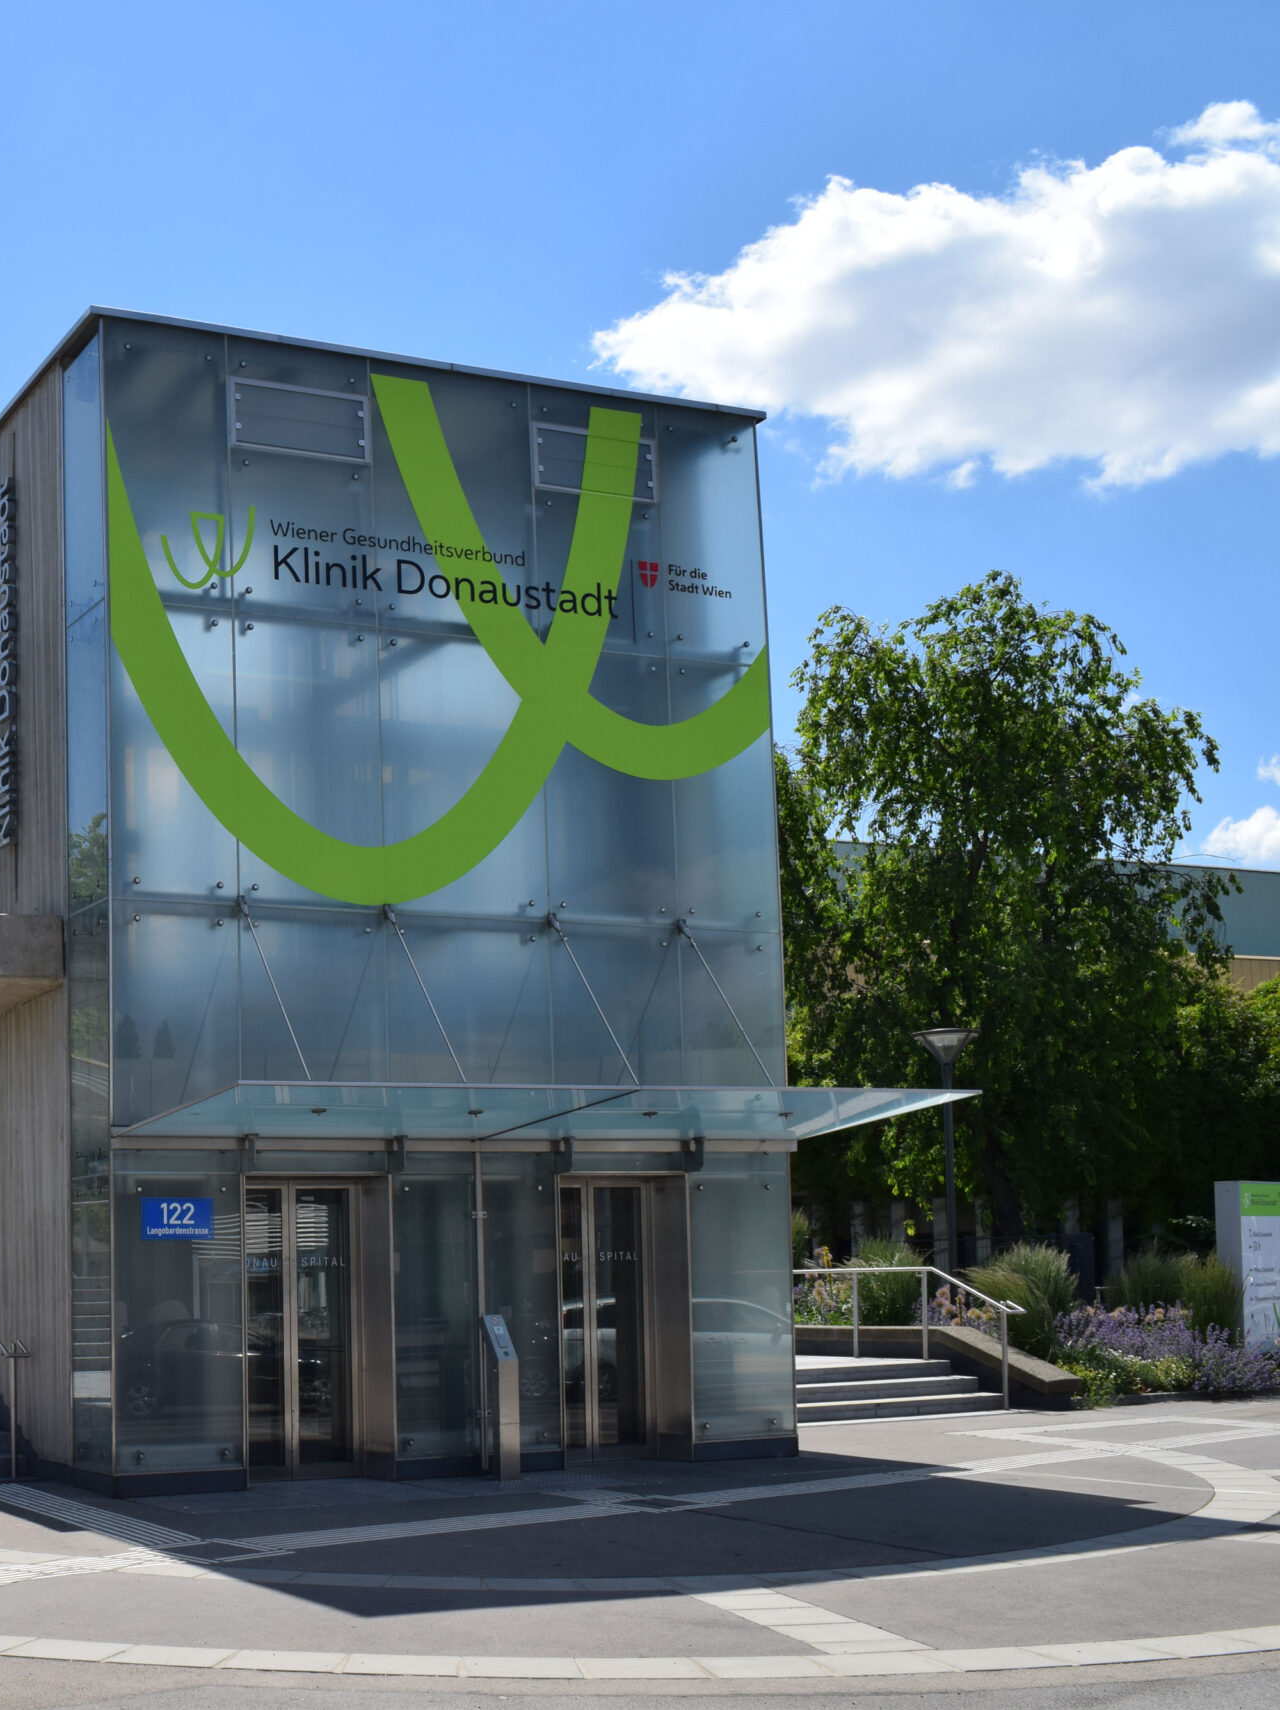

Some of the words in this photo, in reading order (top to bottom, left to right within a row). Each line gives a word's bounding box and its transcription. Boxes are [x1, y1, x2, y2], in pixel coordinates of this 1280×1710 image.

[269, 518, 338, 544] Wiener
[342, 527, 526, 567] Gesundheitsverbund
[272, 543, 383, 593] Klinik
[395, 557, 619, 620] Donaustadt
[667, 563, 688, 578] Für
[689, 567, 708, 581] die
[668, 579, 700, 595] Stadt
[701, 583, 732, 600] Wien
[160, 1202, 195, 1225] 122
[146, 1225, 209, 1237] Langobardenstrasse
[301, 1256, 345, 1267] SPITAL
[599, 1251, 638, 1261] SPITAL
